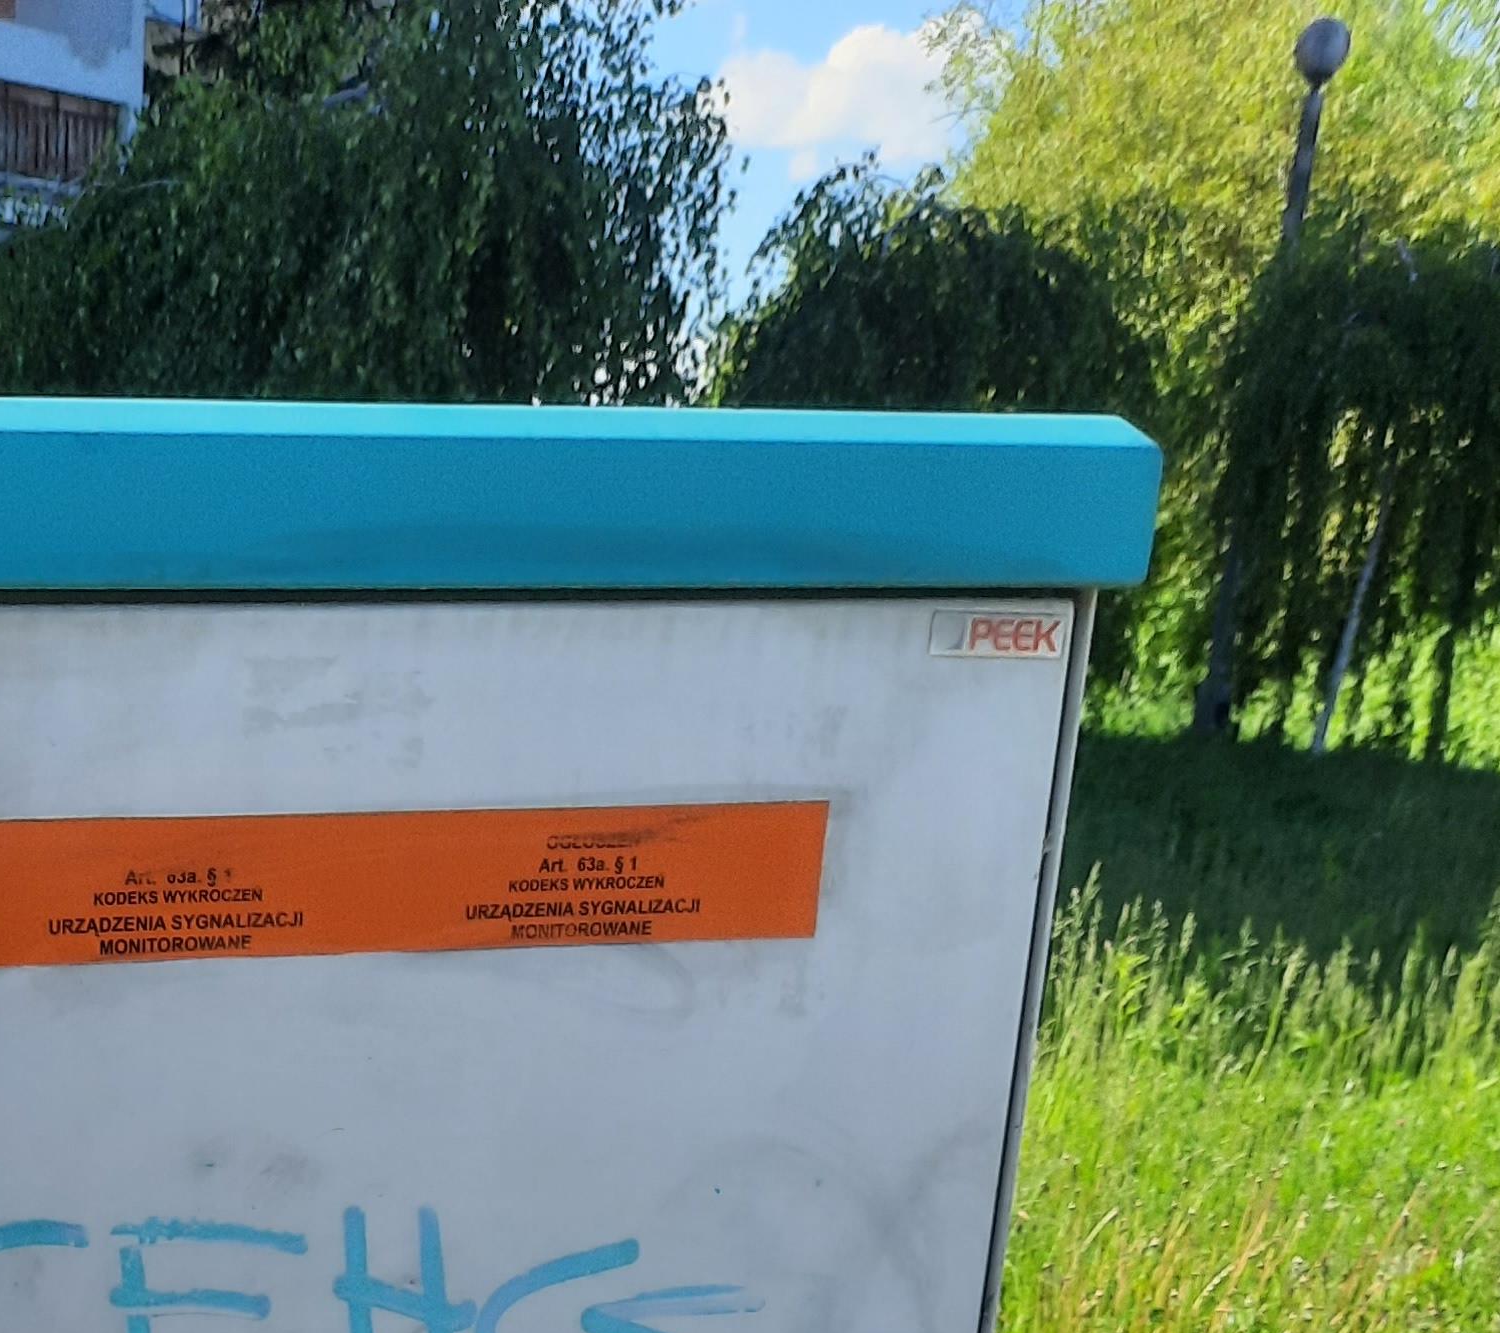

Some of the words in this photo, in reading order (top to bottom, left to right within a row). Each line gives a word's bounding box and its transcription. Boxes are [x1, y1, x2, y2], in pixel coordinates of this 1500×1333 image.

[970, 618, 1061, 652] PEEK
[538, 857, 567, 873] Art.
[630, 857, 638, 871] 1
[508, 878, 568, 893] KODEKS
[93, 891, 158, 907] KODEKS
[466, 901, 574, 922] URZĄDZENIA
[578, 898, 701, 916] SYGNALIZACJI
[49, 915, 167, 937] URZĄDZENIA
[171, 911, 304, 930] SYGNALIZACJI
[511, 920, 652, 940] MONITOROWANE
[100, 935, 252, 956] MONITOROWANE
